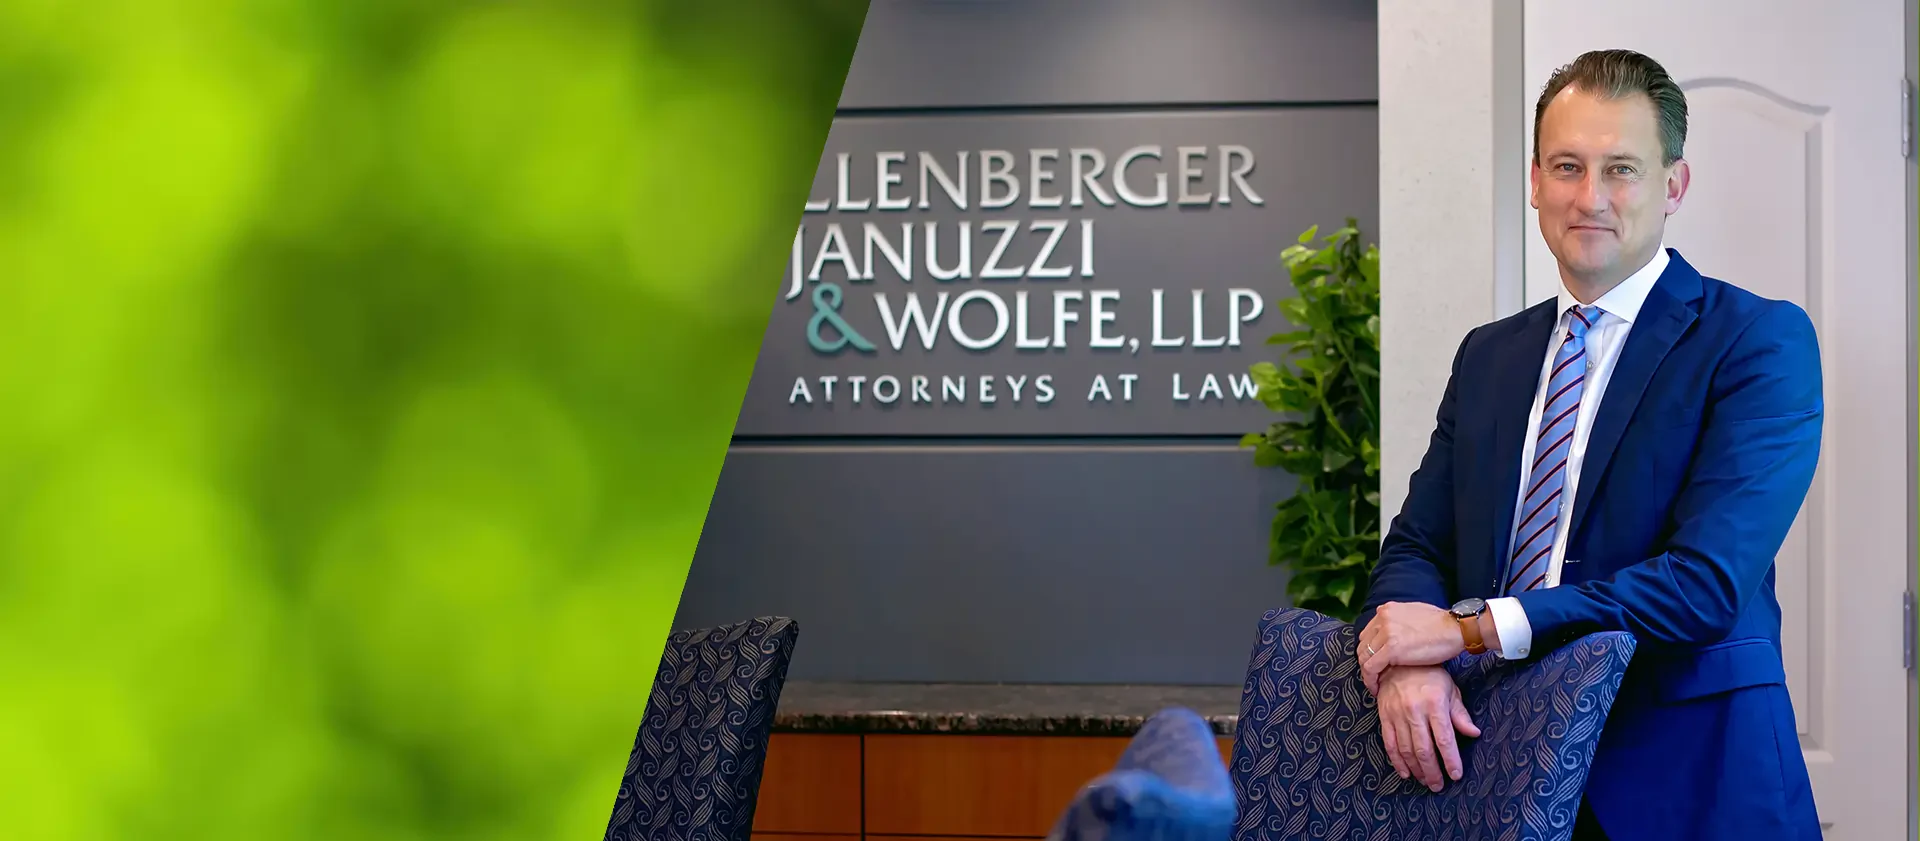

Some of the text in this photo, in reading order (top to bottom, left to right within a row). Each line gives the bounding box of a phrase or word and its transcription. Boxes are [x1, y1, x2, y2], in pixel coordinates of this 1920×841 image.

[786, 220, 1095, 300] JANUZZI
[807, 284, 1264, 353] & WOLFE, LLP
[789, 373, 1259, 403] ATTORNEYS AT LAW
